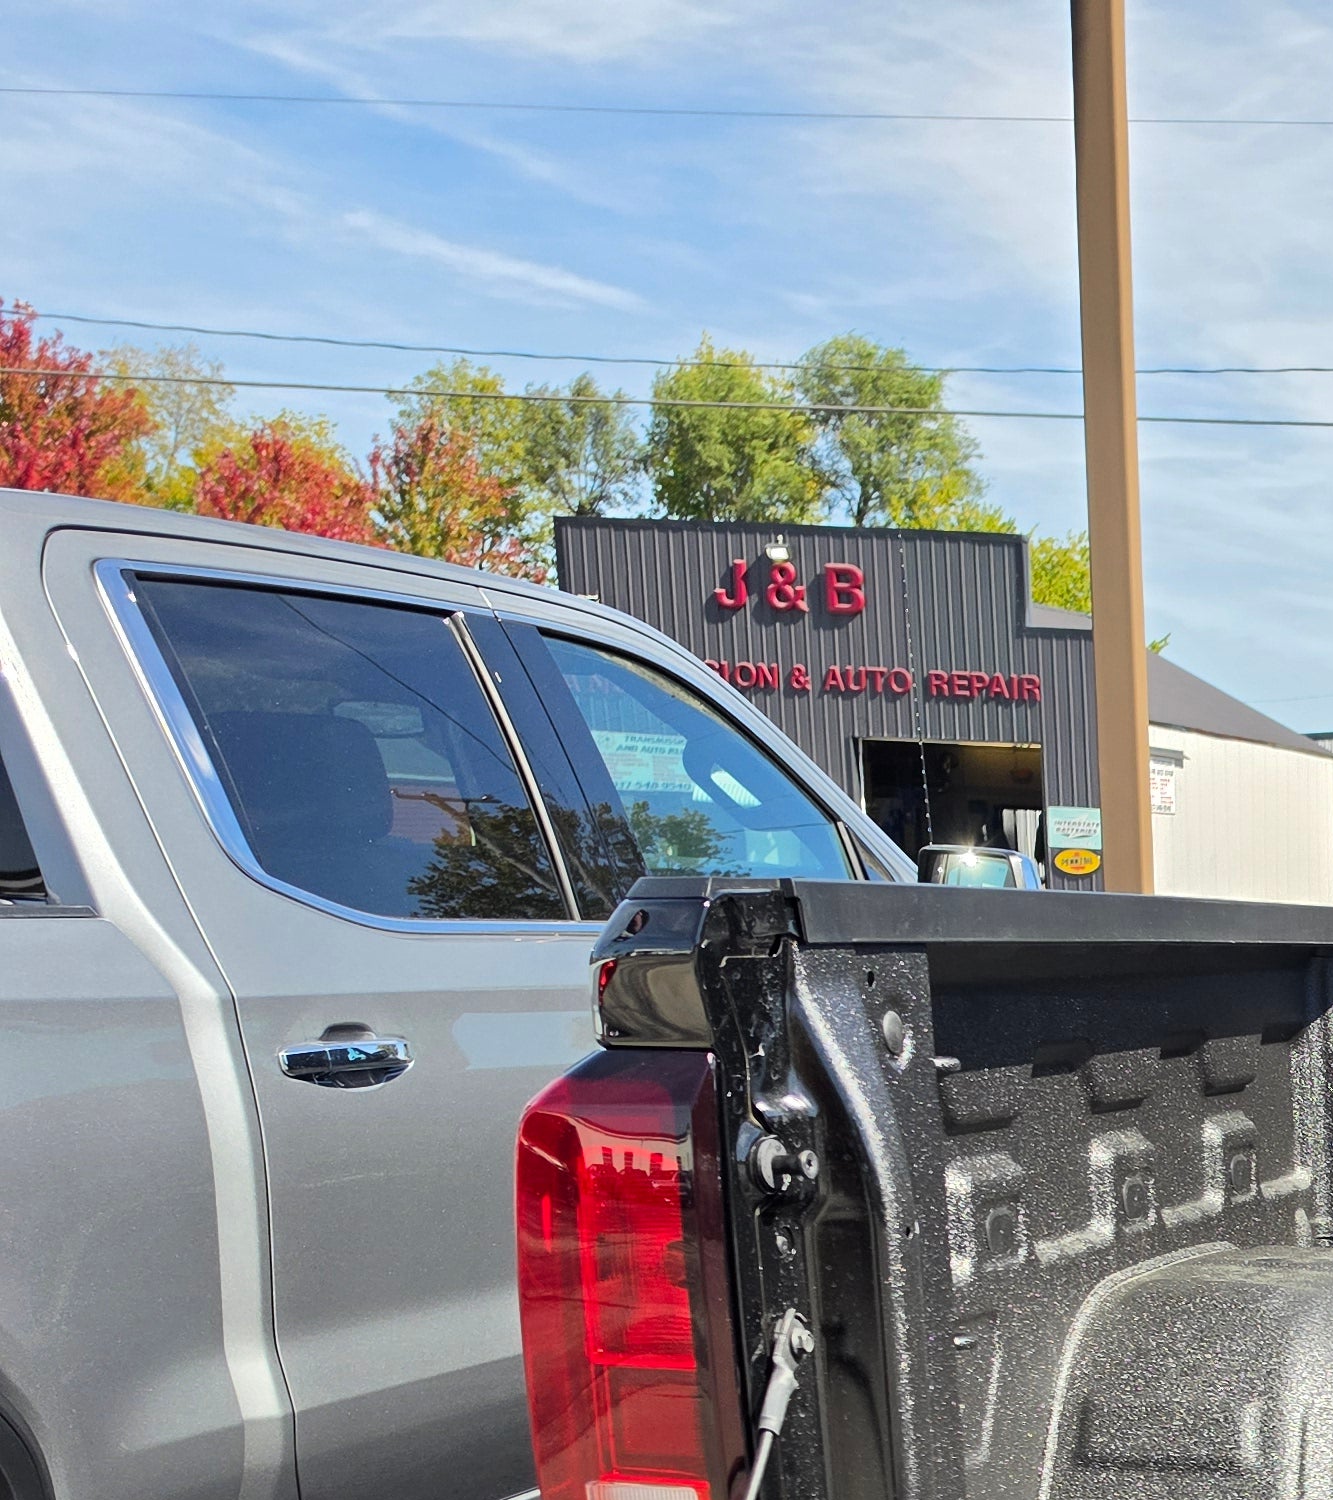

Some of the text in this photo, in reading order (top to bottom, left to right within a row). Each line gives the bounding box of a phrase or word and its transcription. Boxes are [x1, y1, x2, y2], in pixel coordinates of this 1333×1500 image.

[713, 559, 867, 614] J & B
[791, 663, 812, 691] &
[824, 665, 913, 694] AUTO
[928, 669, 1042, 702] REPAIR
